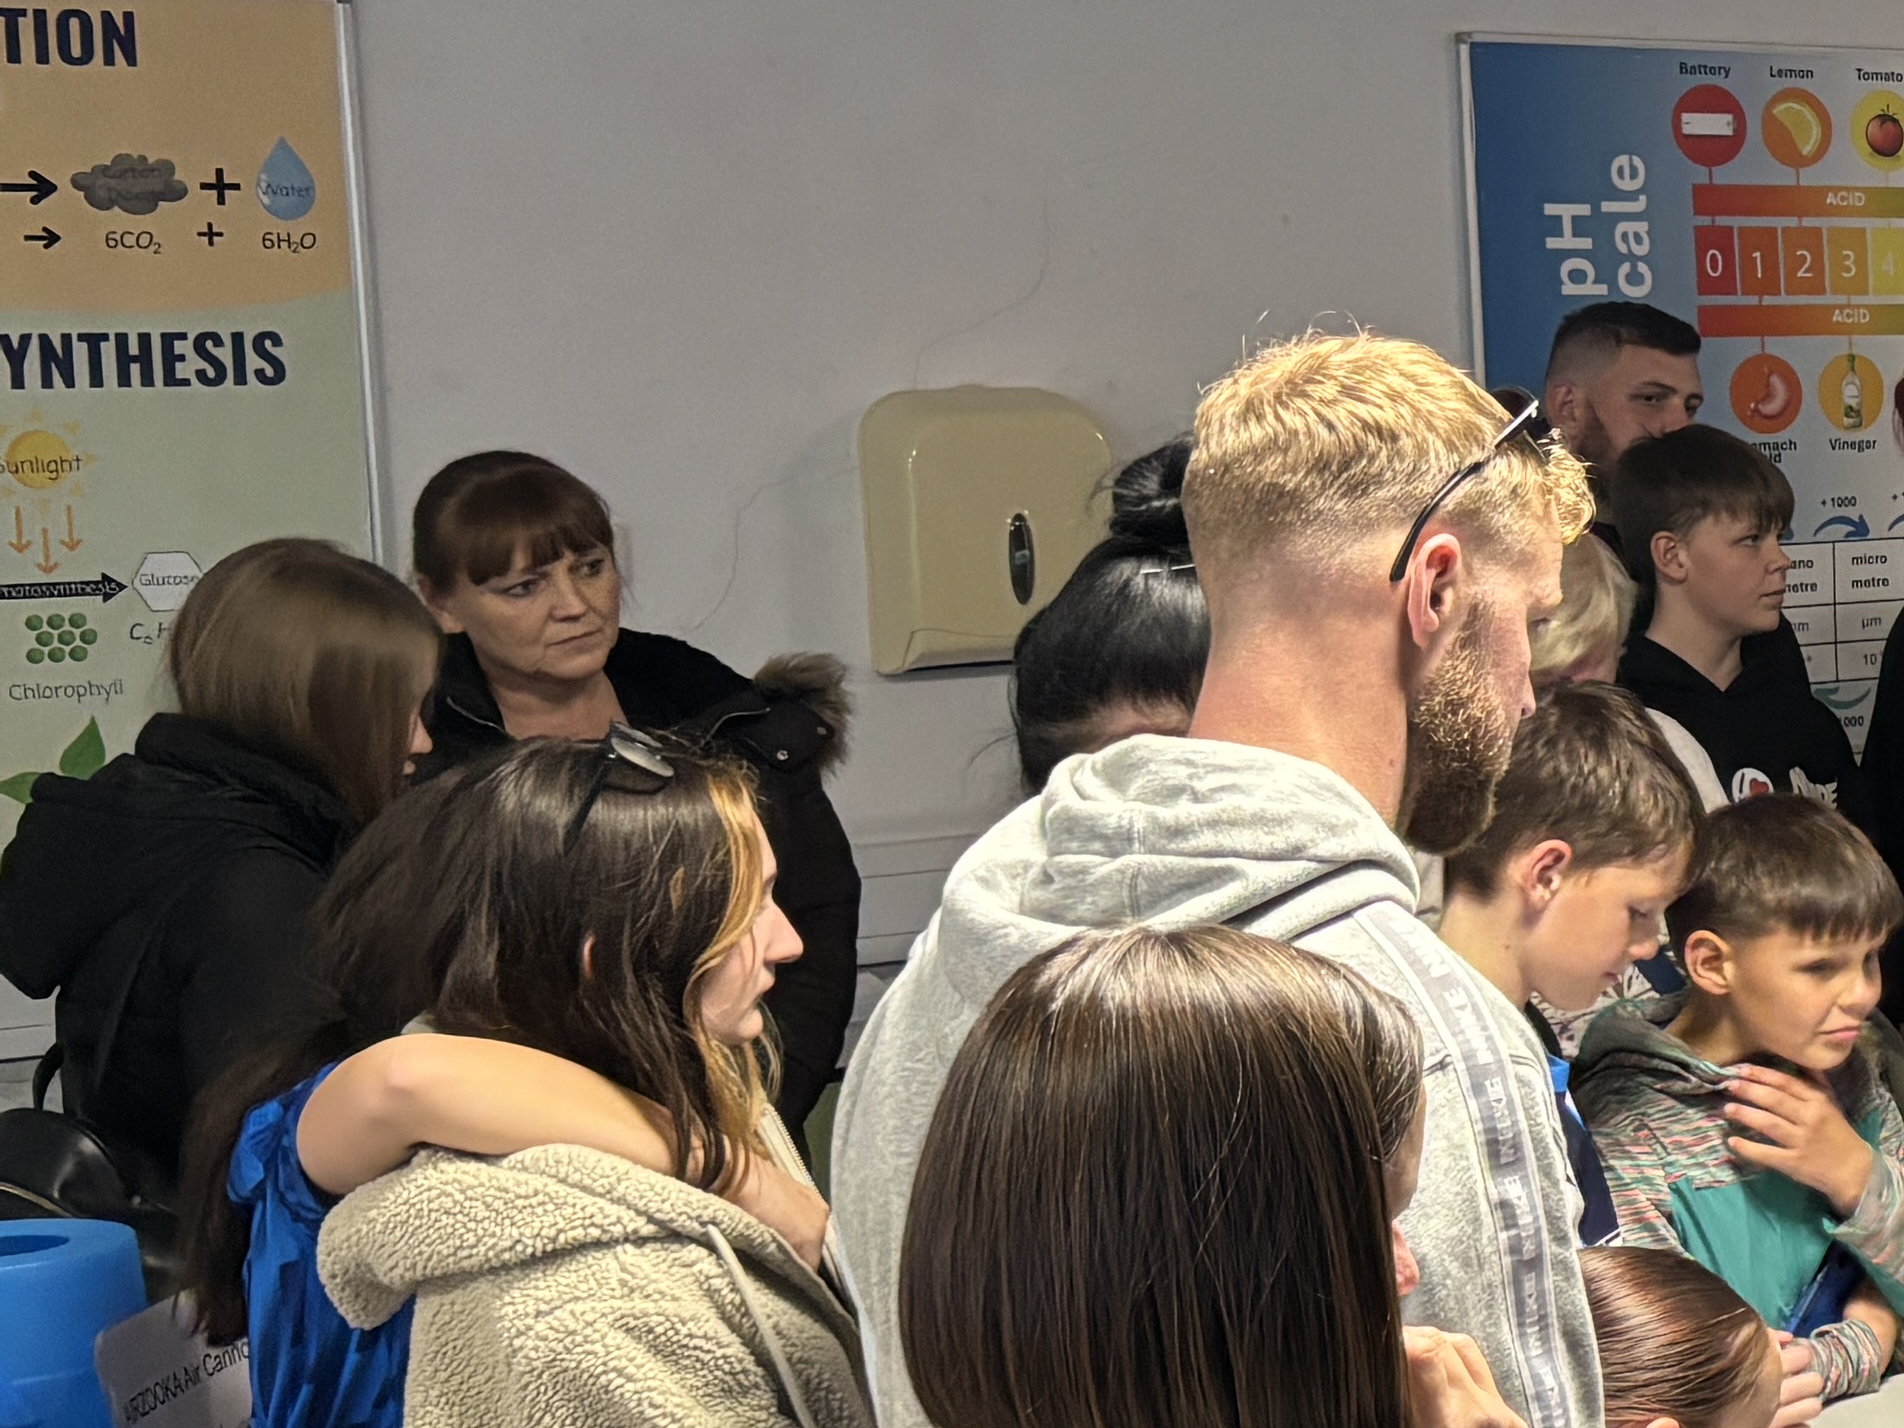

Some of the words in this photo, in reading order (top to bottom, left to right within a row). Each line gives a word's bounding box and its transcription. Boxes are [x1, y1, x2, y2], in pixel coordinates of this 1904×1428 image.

[0, 7, 138, 67] TION
[1678, 61, 1731, 80] Battery
[1769, 65, 1814, 80] Lemon
[1855, 68, 1904, 84] Tomato
[258, 182, 312, 199] Water
[1826, 192, 1865, 206] ACID
[1544, 203, 1608, 296] pH
[1601, 154, 1652, 298] cale
[1706, 249, 1723, 277] 0
[1752, 252, 1762, 278] 1
[1796, 251, 1813, 277] 2
[1841, 251, 1856, 277] 3
[1832, 308, 1870, 323] ACID
[0, 331, 287, 390] YNTHESIS
[1829, 438, 1877, 453] Vinegar
[1830, 495, 1857, 509] 1000
[1790, 559, 1814, 570] ano
[1851, 553, 1888, 566] micro
[1851, 576, 1890, 590] metre
[9, 679, 123, 705] Chlorophyll
